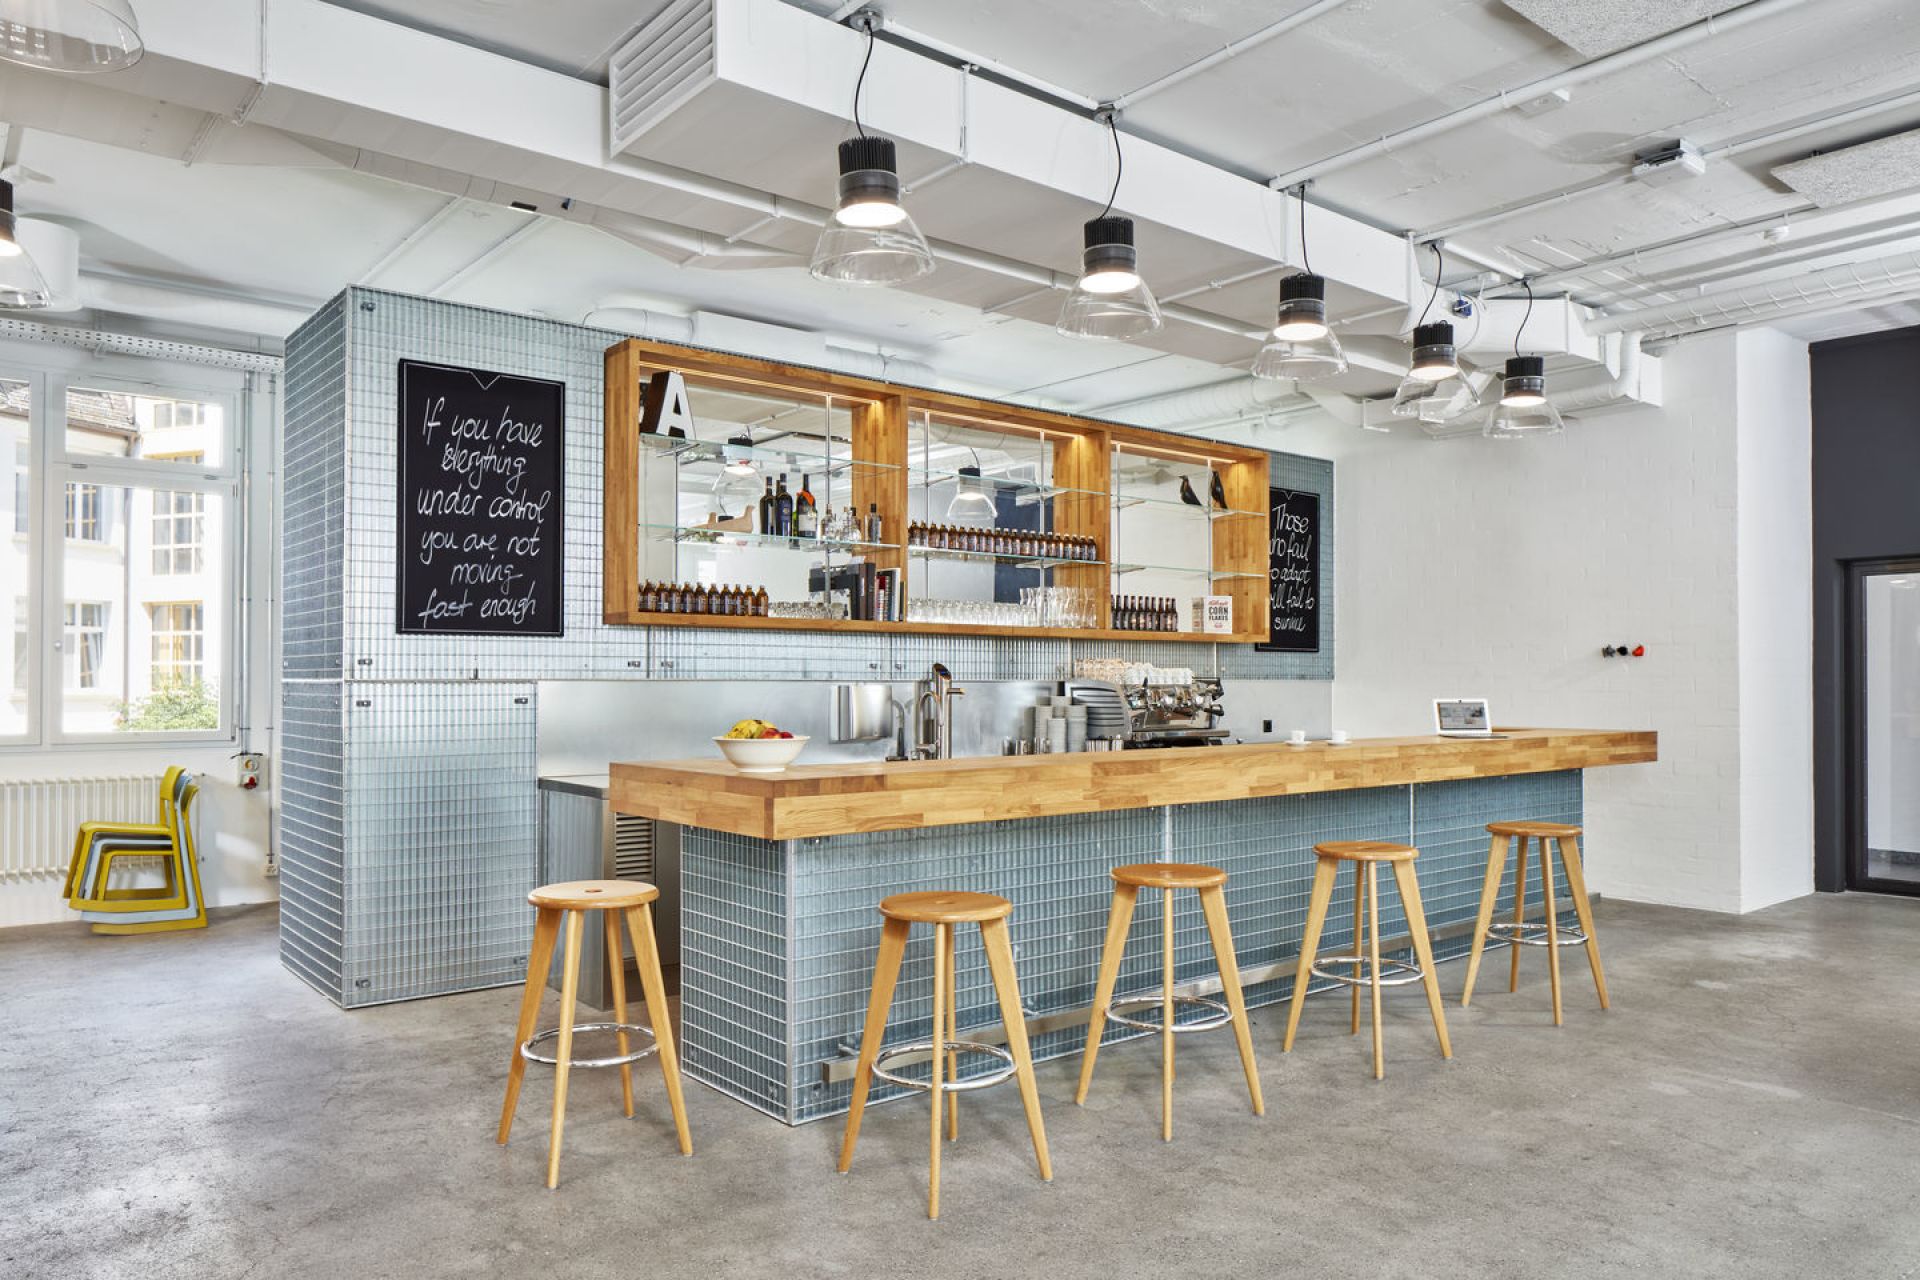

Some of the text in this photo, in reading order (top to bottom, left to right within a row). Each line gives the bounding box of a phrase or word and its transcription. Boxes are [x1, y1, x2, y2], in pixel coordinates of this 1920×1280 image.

[422, 396, 543, 452] If you have
[655, 371, 697, 441] A
[417, 483, 552, 524] under control
[1271, 502, 1309, 534] Those
[420, 526, 540, 565] you are not
[1269, 528, 1312, 567] ho fail
[450, 554, 523, 595] moving
[1269, 562, 1311, 590] o adapt
[418, 580, 536, 629] fast enough
[1208, 606, 1228, 616] CORN
[1270, 582, 1316, 613] ill fail to
